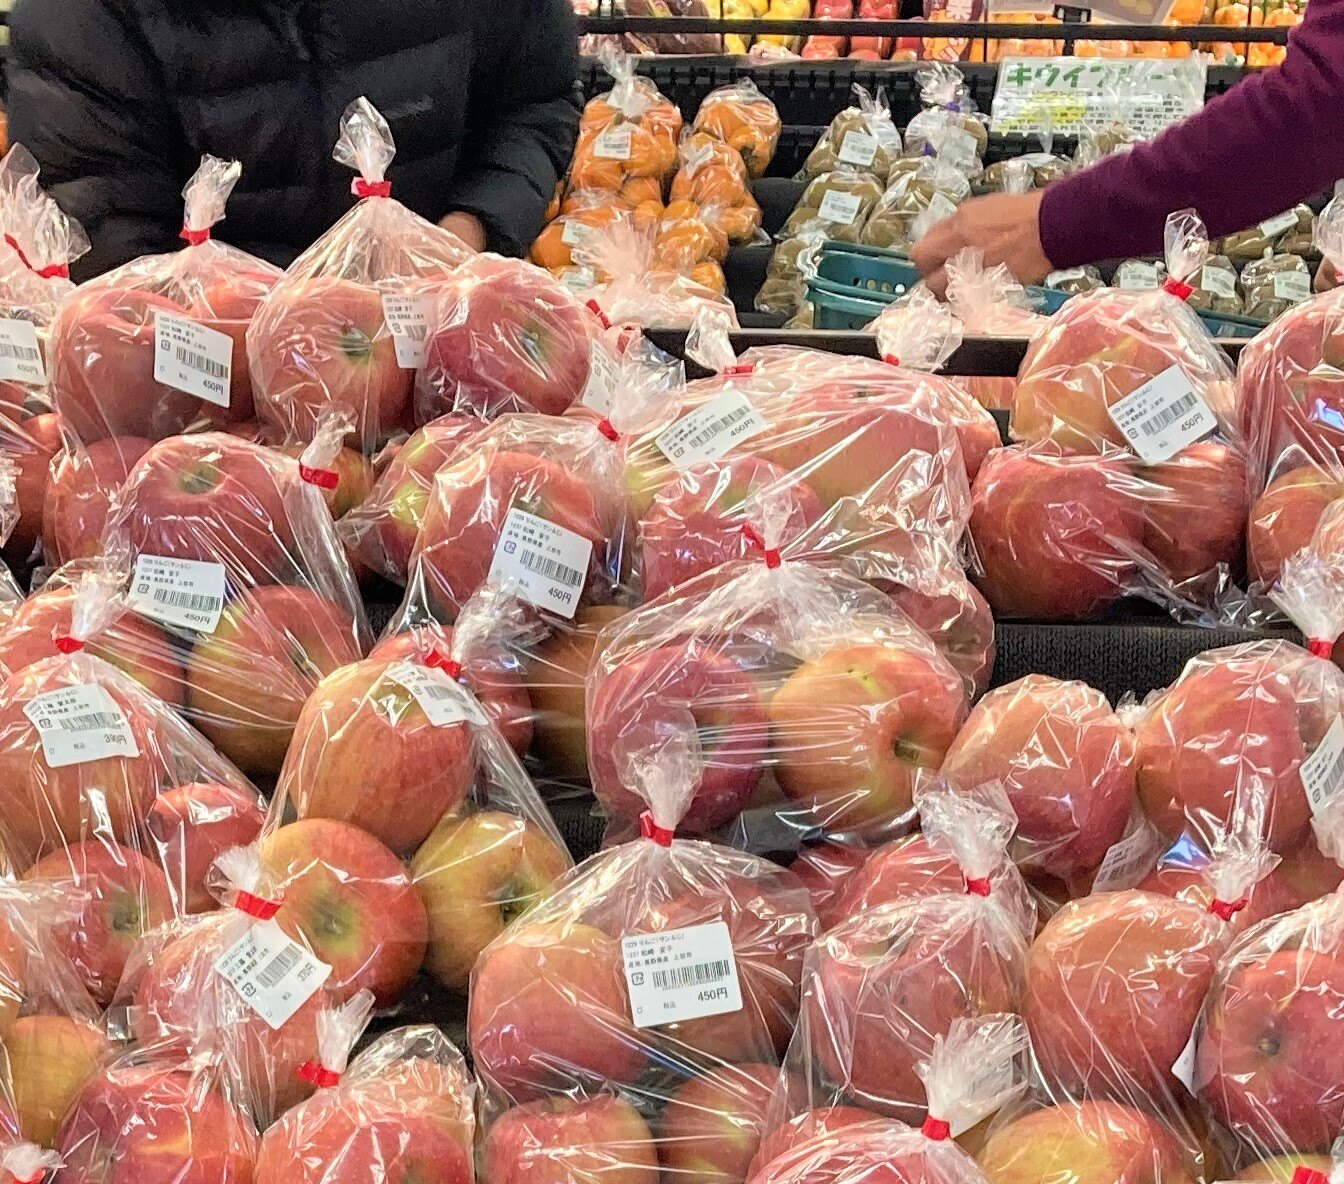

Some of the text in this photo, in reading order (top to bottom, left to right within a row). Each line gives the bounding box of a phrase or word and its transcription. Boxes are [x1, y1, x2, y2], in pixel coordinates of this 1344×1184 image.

[202, 378, 224, 395] 450円
[1178, 411, 1205, 433] 450円
[547, 585, 572, 605] 450円
[696, 987, 729, 1003] 450円
